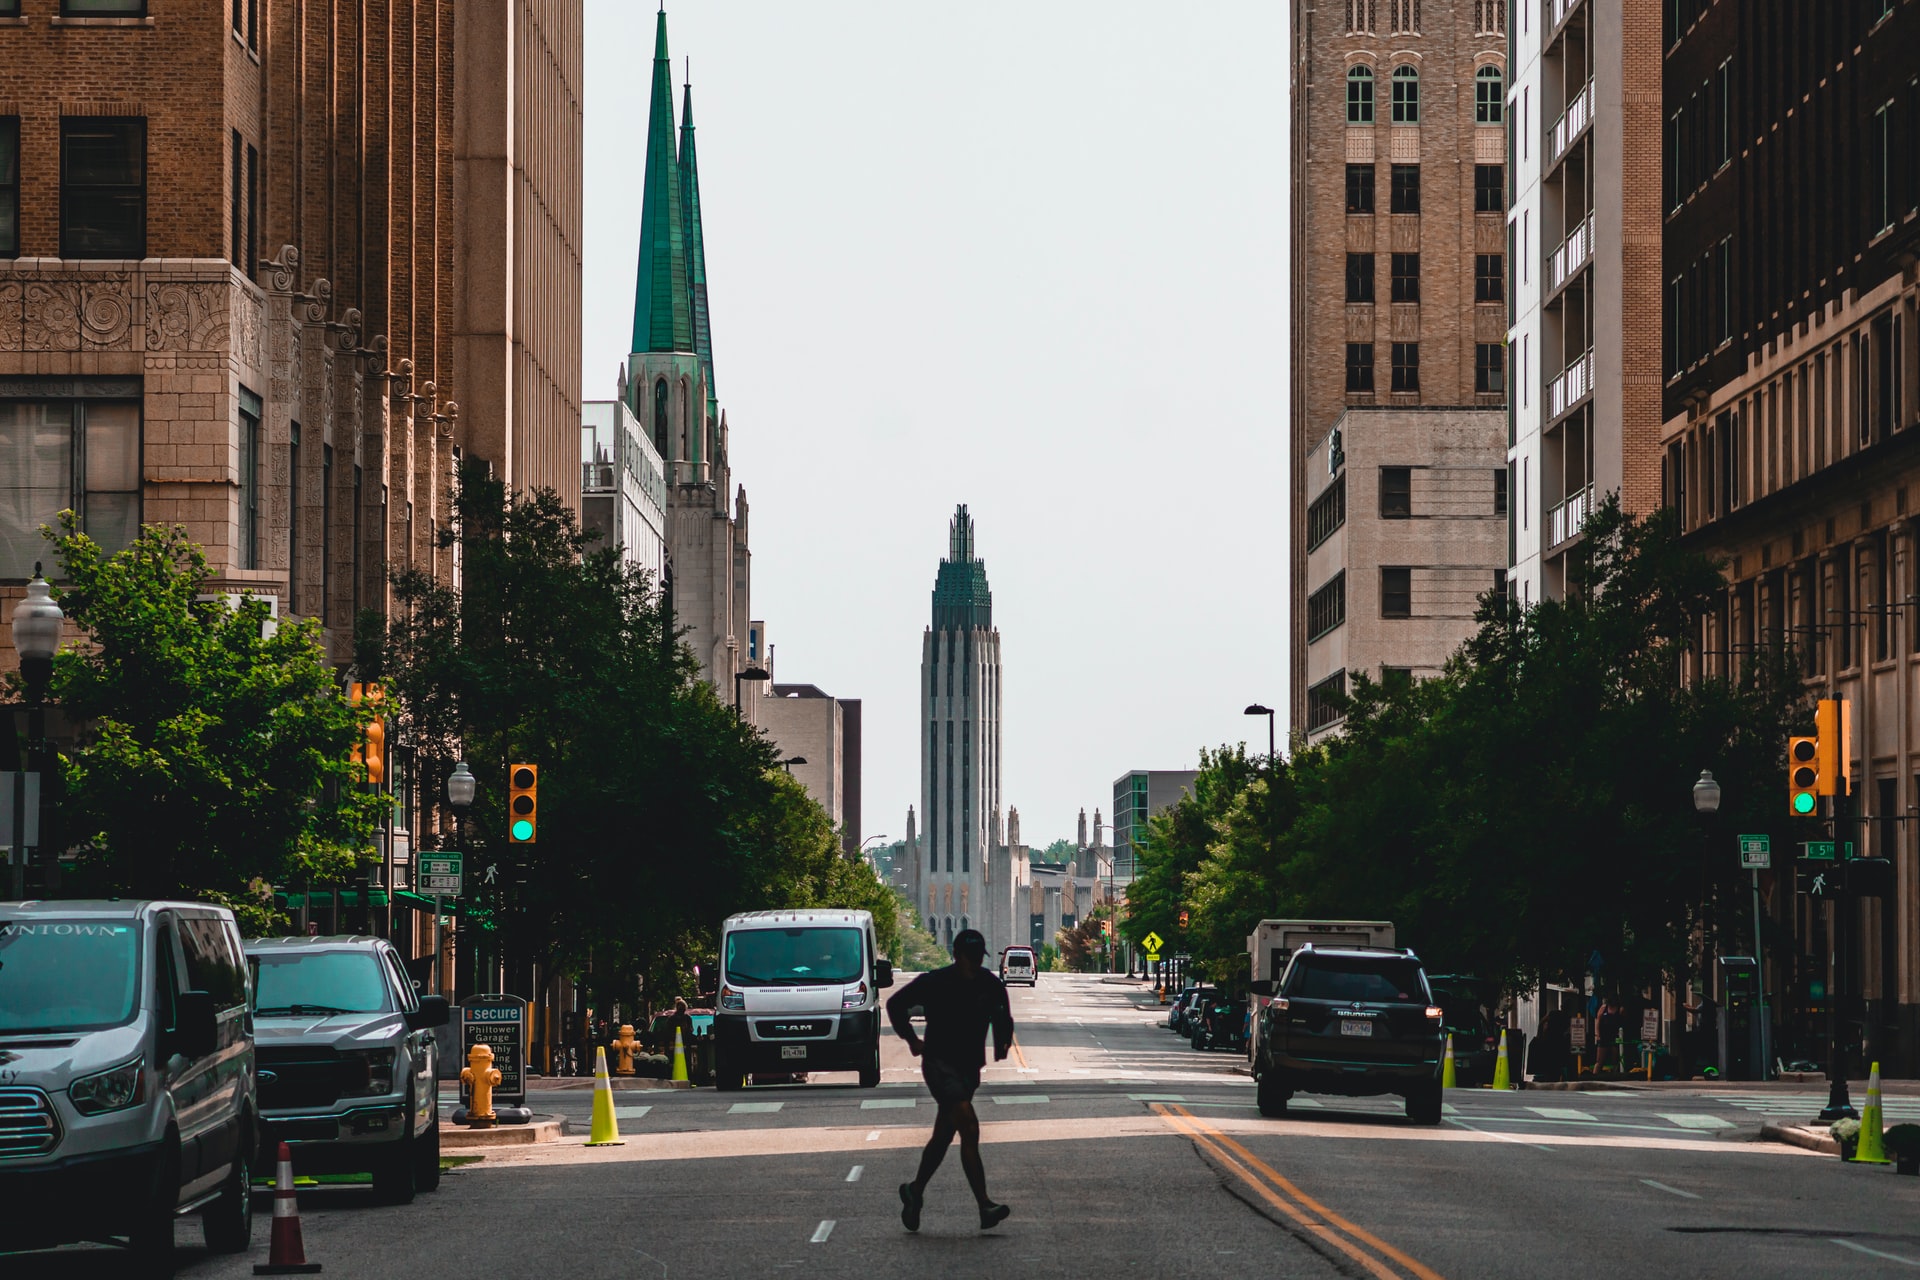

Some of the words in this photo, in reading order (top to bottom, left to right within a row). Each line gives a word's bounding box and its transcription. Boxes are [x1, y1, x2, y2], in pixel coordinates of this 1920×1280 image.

[474, 1008, 518, 1020] secure
[468, 1025, 515, 1034] Philtower
[475, 1033, 510, 1043] Garage
[493, 1045, 511, 1054] thly
